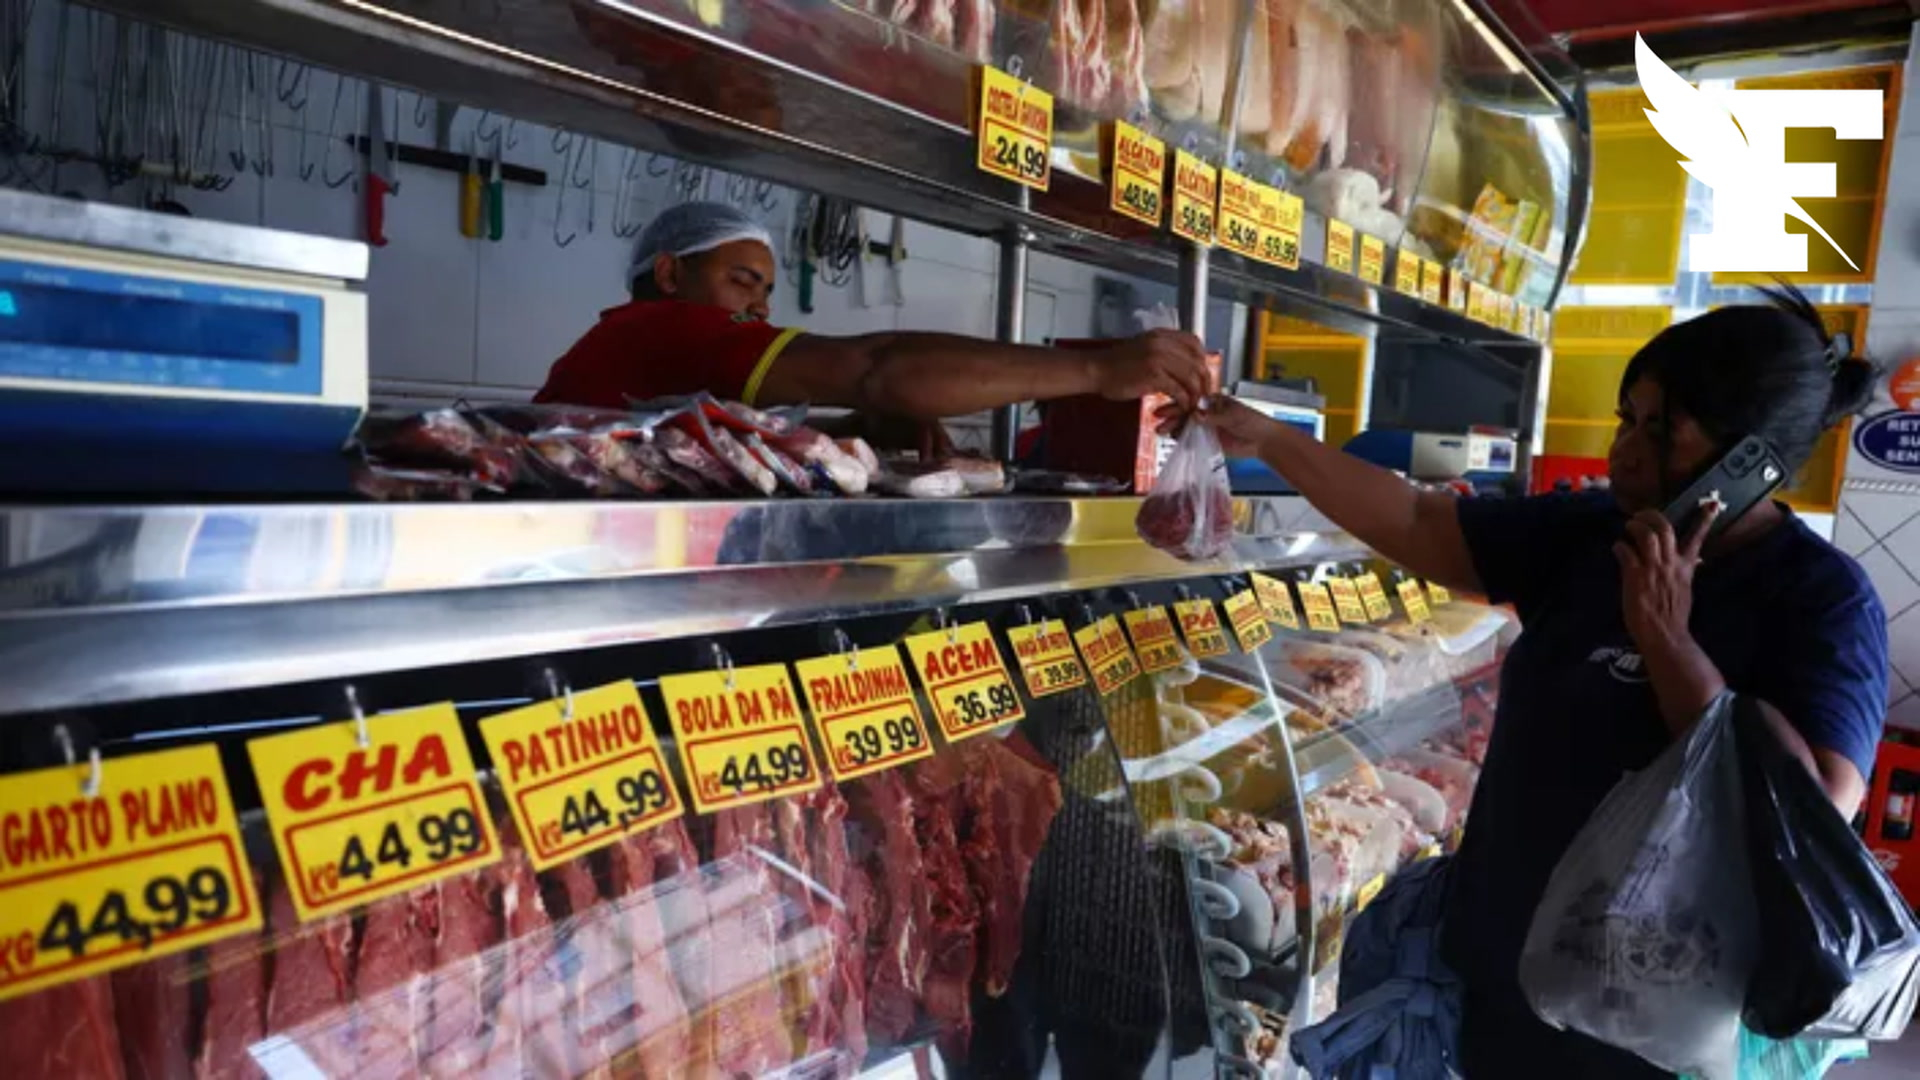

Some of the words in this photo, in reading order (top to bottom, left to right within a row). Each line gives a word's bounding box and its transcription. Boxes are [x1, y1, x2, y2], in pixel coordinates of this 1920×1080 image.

[997, 136, 1046, 178] 24,99
[925, 638, 997, 681] ACEM
[676, 694, 733, 734] BOLA
[735, 689, 766, 726] DA
[766, 679, 795, 721] PÁ
[809, 664, 909, 713] FRALDINHA
[954, 684, 1017, 723] 36,99
[502, 704, 644, 783] PATINHO
[720, 743, 809, 793] 44,99
[283, 734, 451, 813] CHA
[0, 796, 112, 874] GARTO
[119, 777, 218, 842] PLANO
[561, 769, 667, 834] 44,99
[309, 862, 340, 896] KG
[38, 867, 230, 957] 44,99
